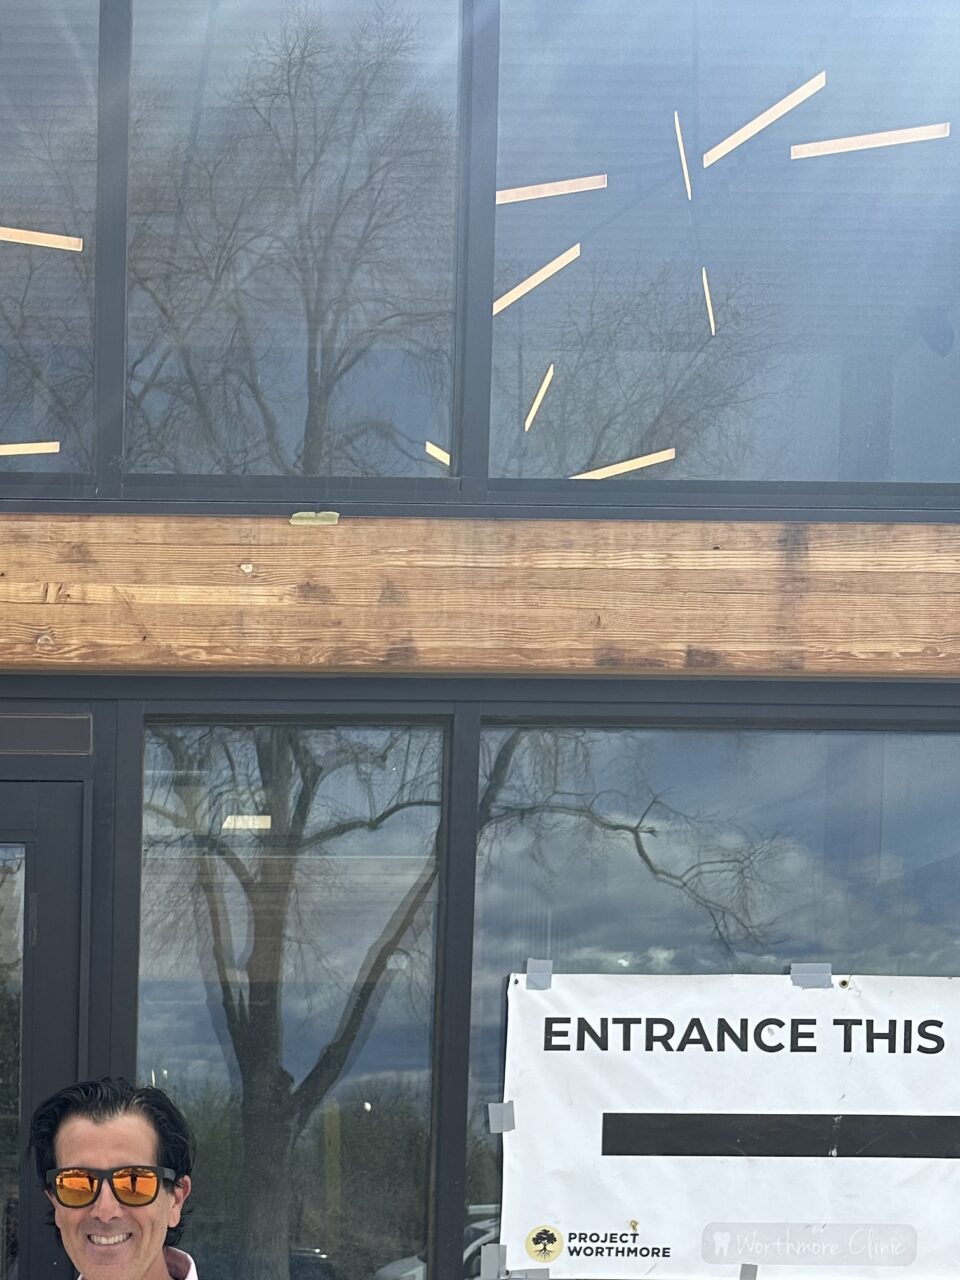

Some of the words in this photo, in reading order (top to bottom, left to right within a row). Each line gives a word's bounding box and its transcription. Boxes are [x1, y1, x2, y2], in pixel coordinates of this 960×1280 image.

[543, 1016, 818, 1053] ENTRANCE
[832, 1018, 946, 1055] THIS
[567, 1232, 640, 1245] PROJECT
[734, 1226, 842, 1257] Worthmore
[847, 1226, 906, 1261] Clinic
[567, 1246, 672, 1259] WORTHMORE
